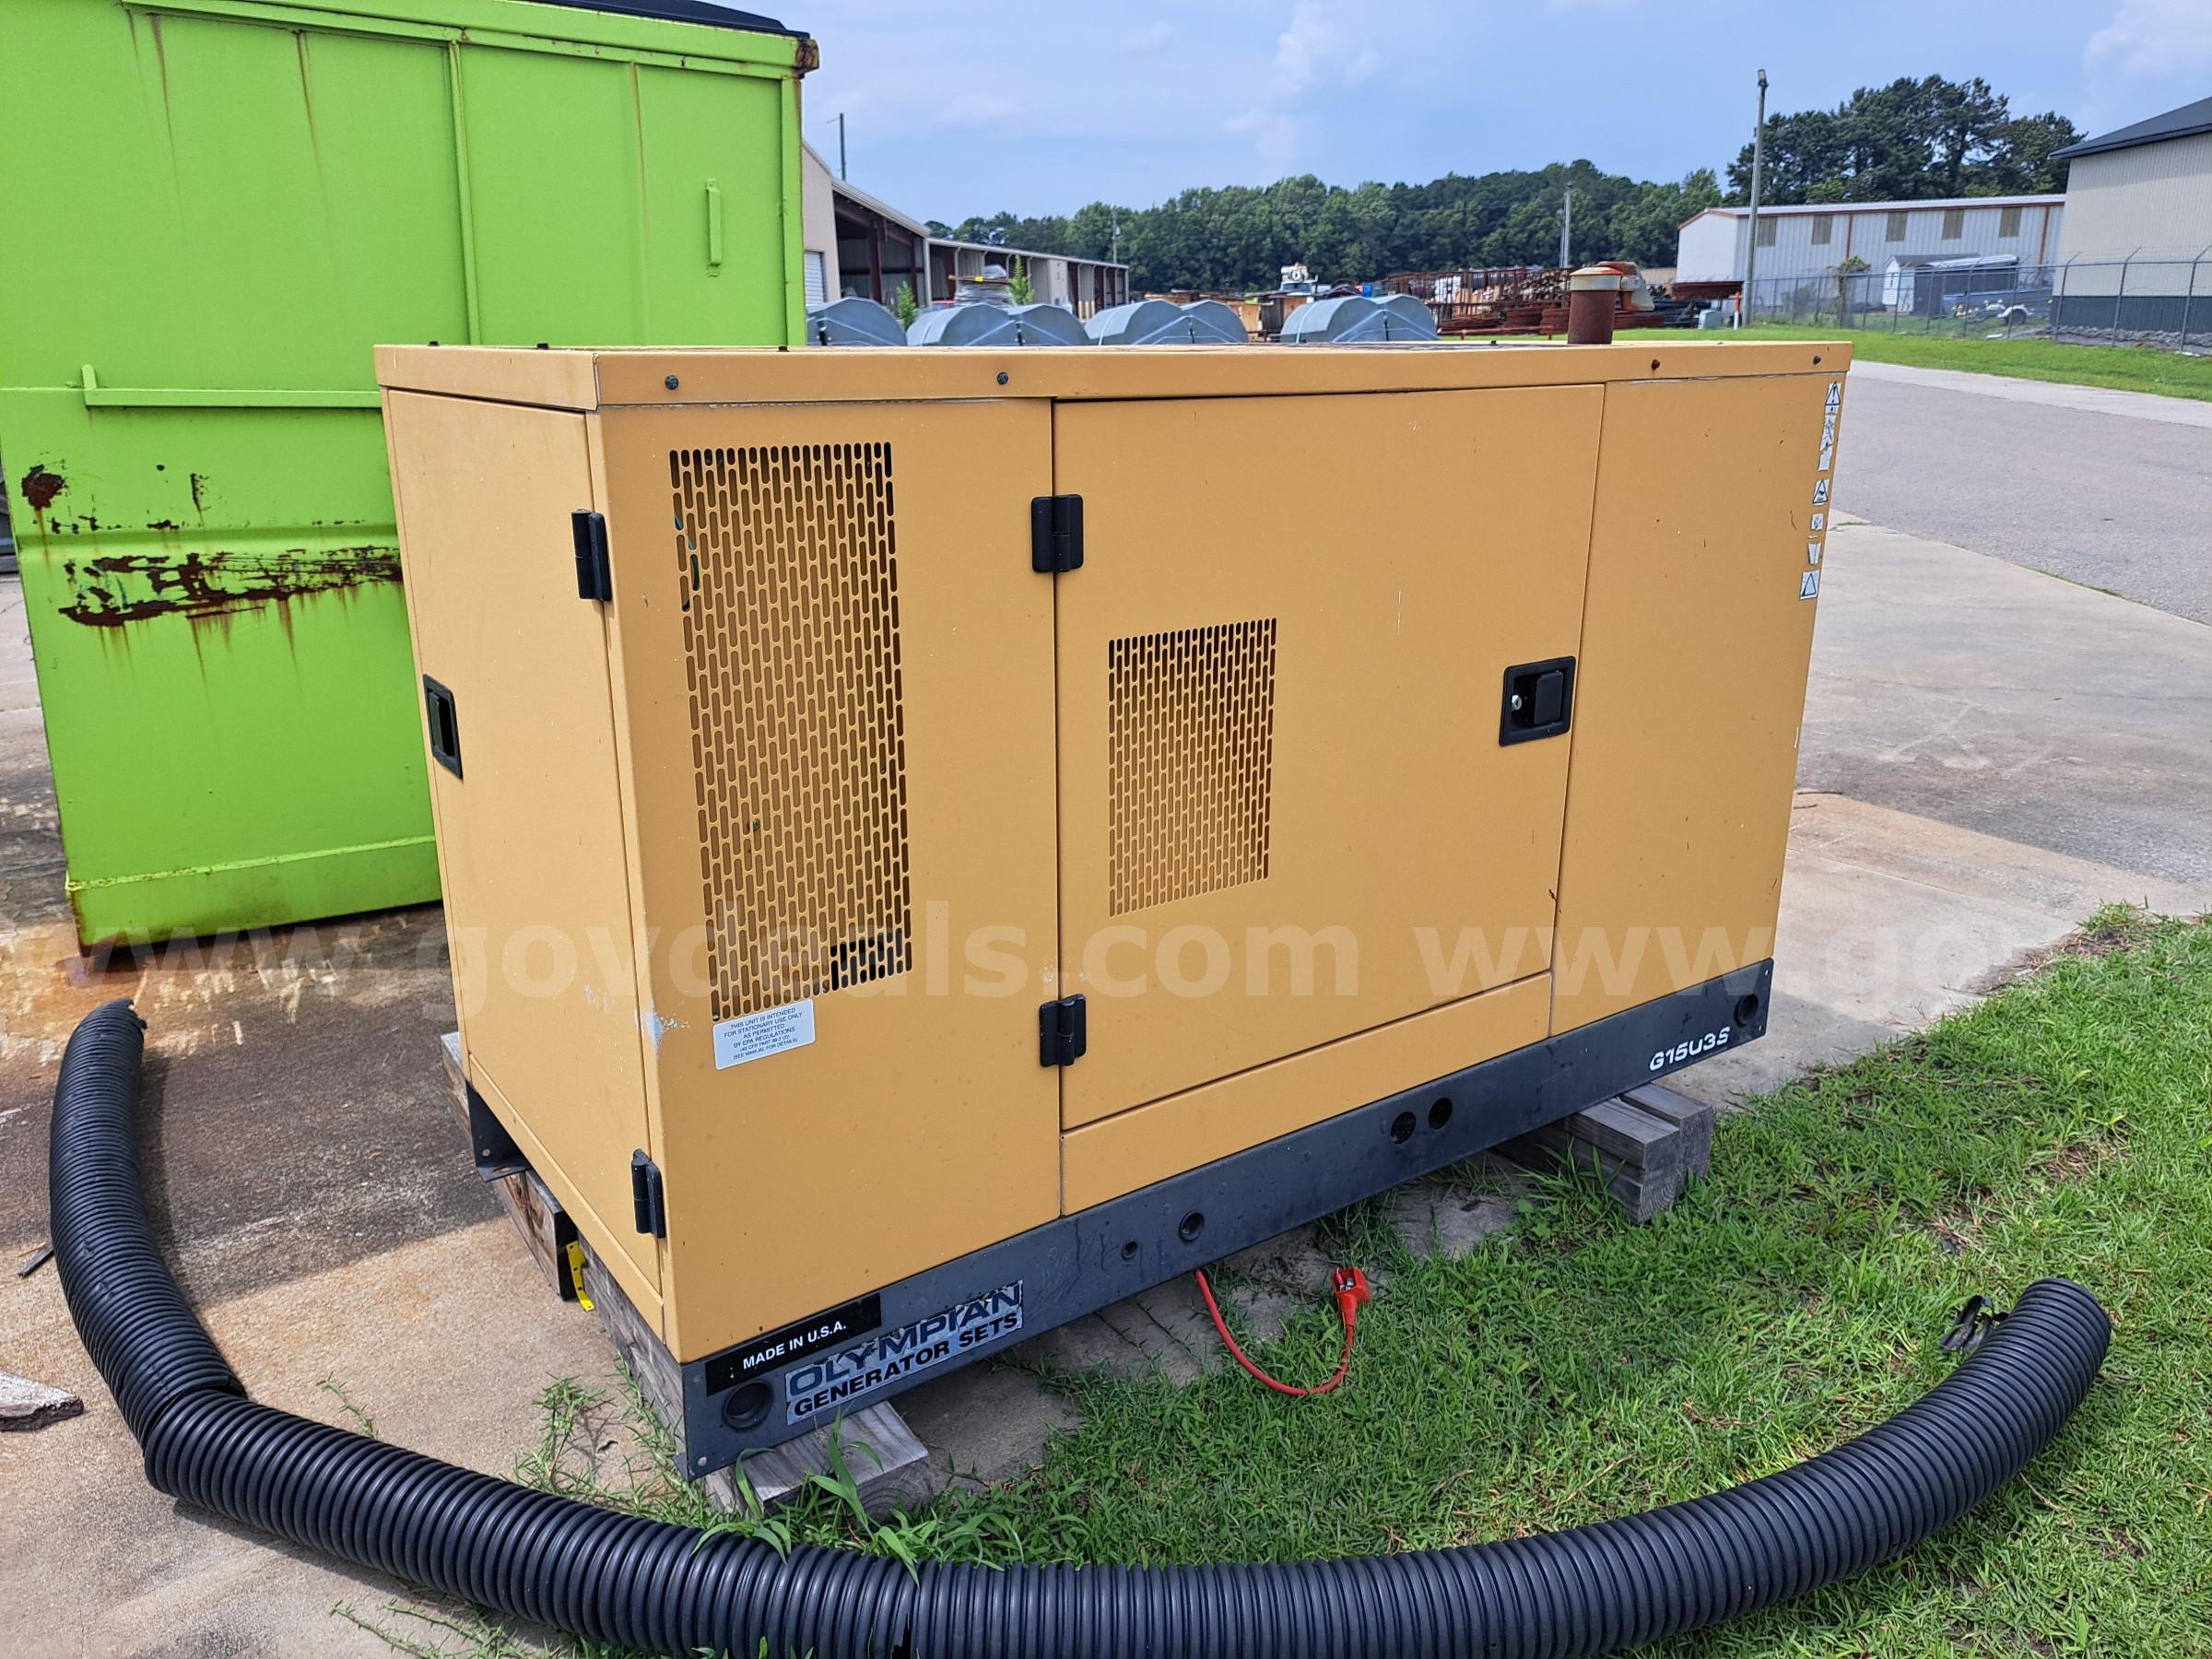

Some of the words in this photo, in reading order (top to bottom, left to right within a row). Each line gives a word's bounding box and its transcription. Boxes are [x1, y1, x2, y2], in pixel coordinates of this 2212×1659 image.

[724, 1030, 737, 1038] FOR
[737, 1020, 774, 1033] STATIONARY
[774, 1017, 787, 1025] USE
[788, 1012, 803, 1020] ONLY
[730, 1021, 744, 1030] THIS
[745, 1018, 759, 1026] UNIT
[767, 1007, 796, 1019] INTENDED
[753, 1023, 785, 1036] PERMITTED
[755, 1026, 795, 1041] REGULATIONS
[1649, 1026, 1731, 1071] G15U3S
[742, 1343, 786, 1370] MADE
[789, 1335, 804, 1351] IN
[807, 1320, 847, 1343] U.S.A.
[789, 1283, 1022, 1396] OLYMPIAN
[794, 1342, 950, 1417] GENERATOR
[959, 1311, 1018, 1348] SETS
